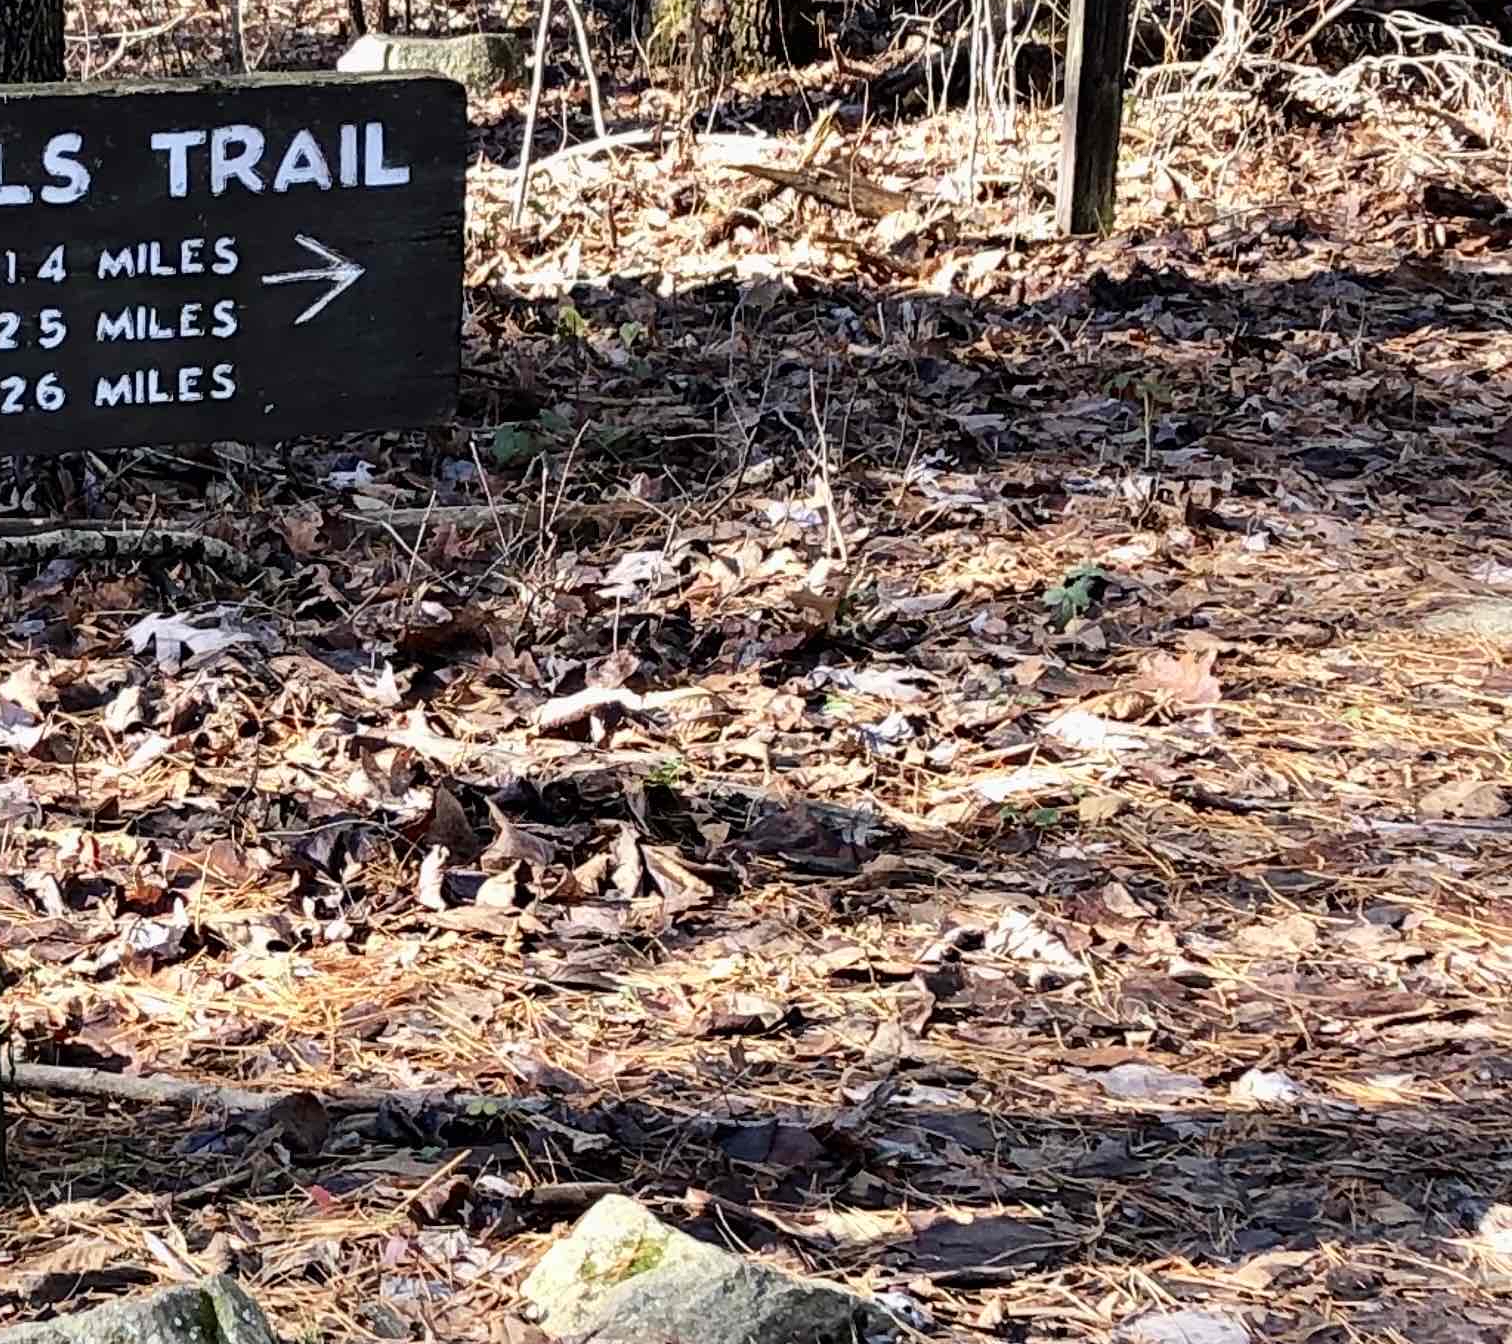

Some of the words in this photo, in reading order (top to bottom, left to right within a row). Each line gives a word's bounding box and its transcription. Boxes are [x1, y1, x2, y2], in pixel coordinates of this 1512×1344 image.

[151, 121, 411, 197] TRAIL
[97, 237, 238, 279] MILES
[96, 299, 237, 342] MILES
[95, 363, 236, 407] MILES
